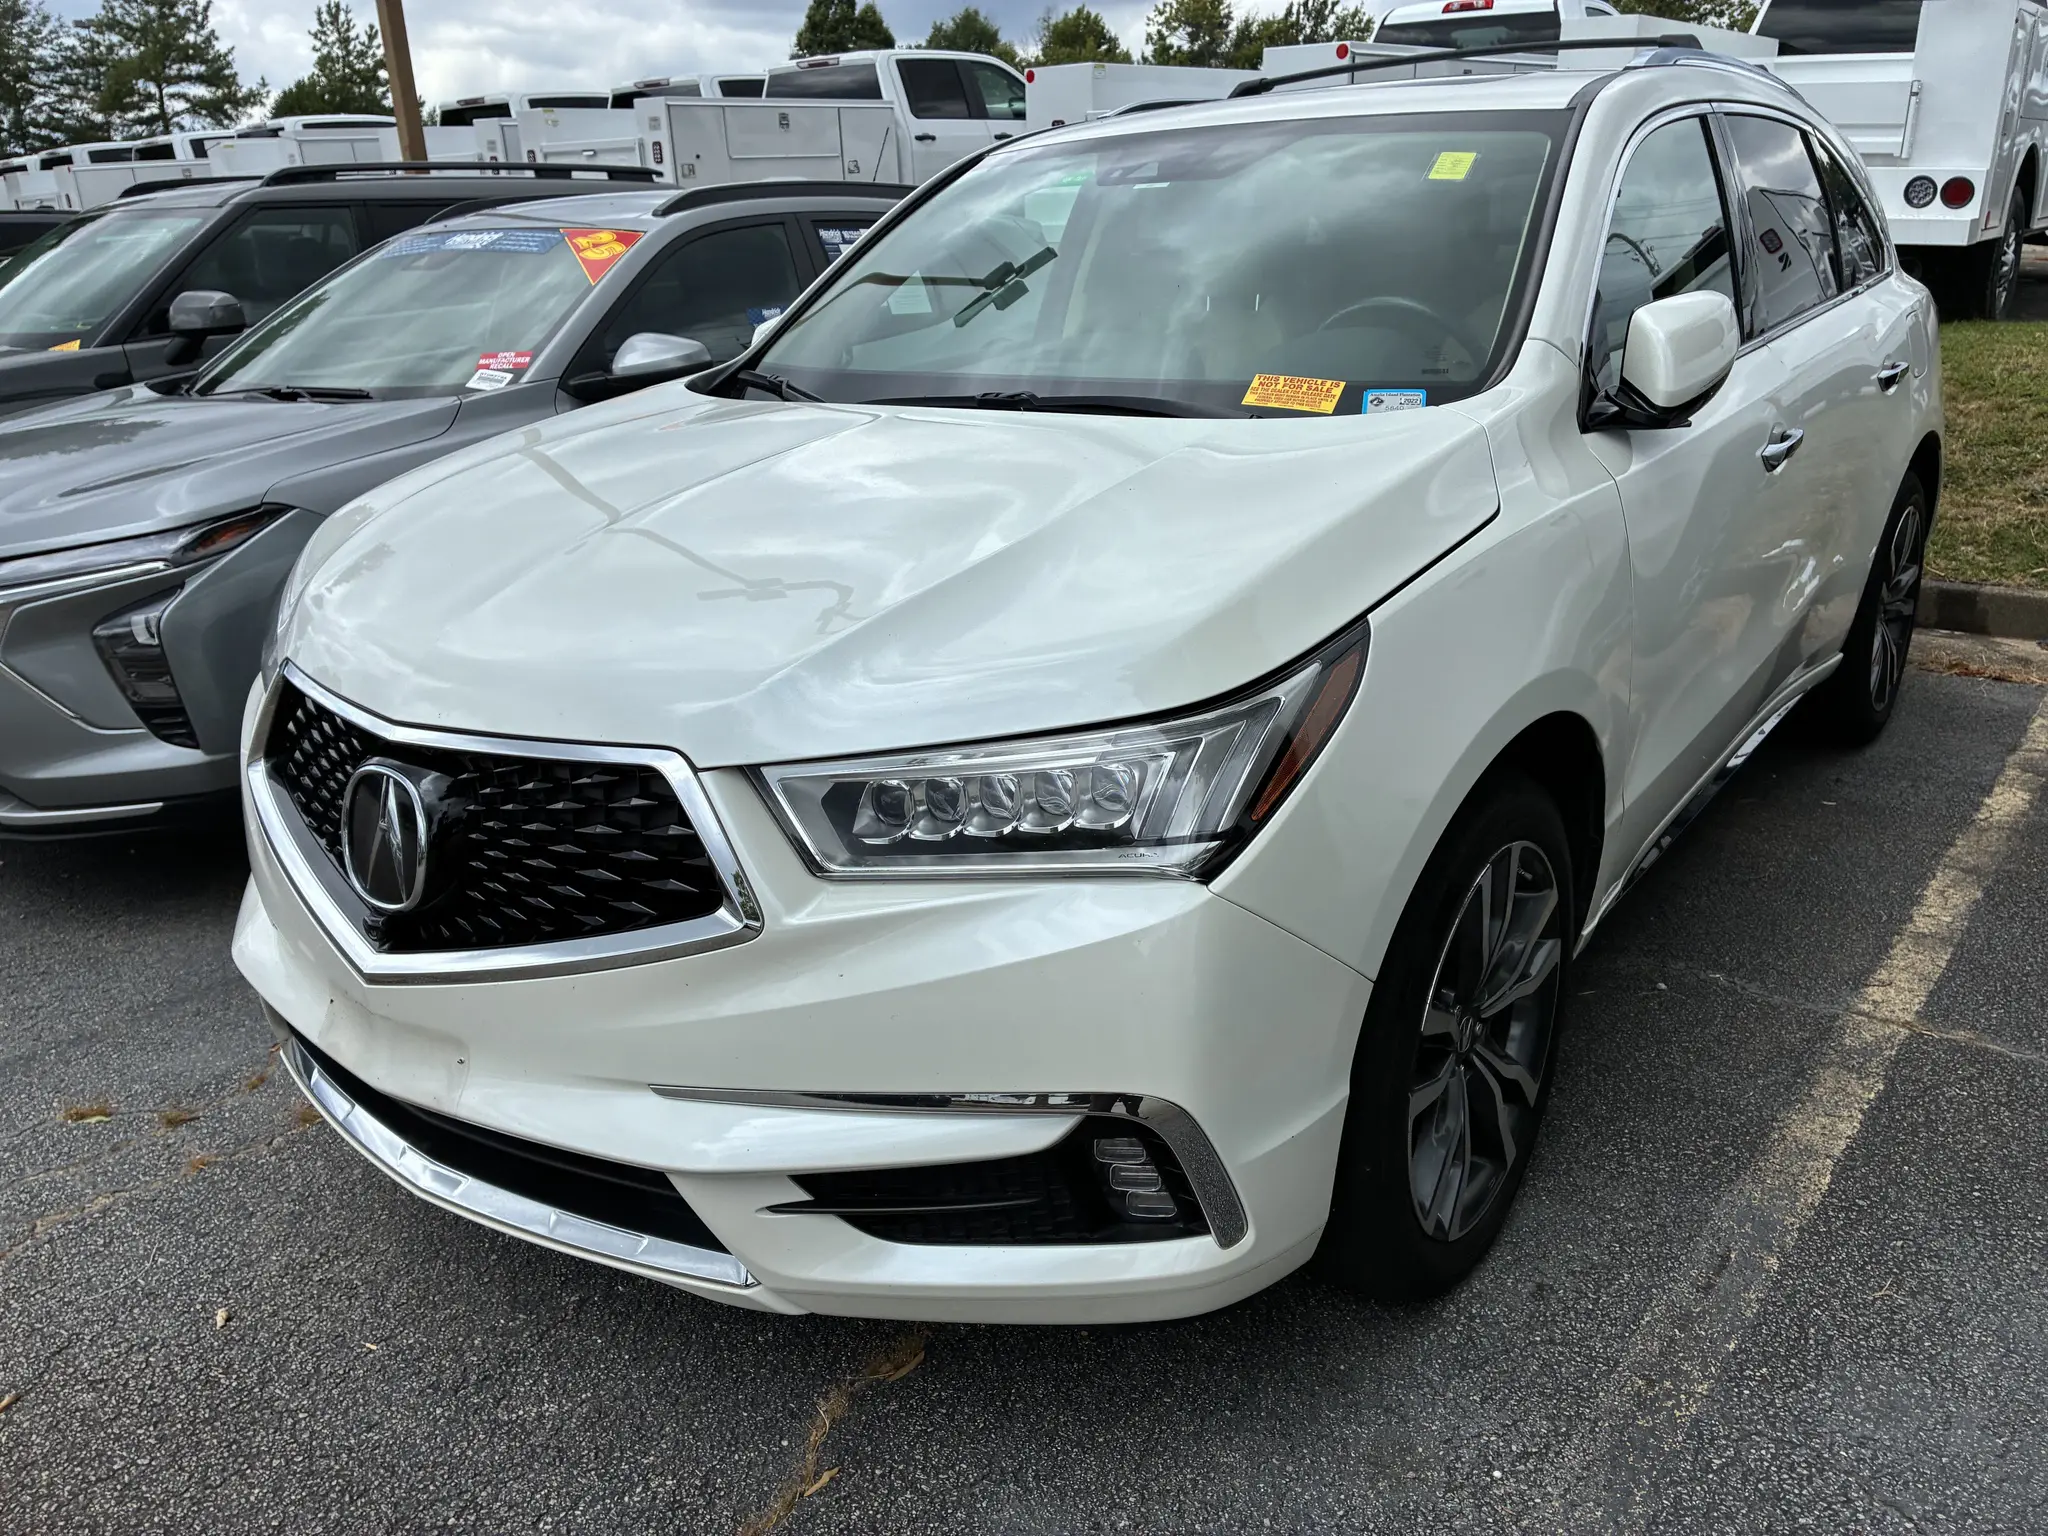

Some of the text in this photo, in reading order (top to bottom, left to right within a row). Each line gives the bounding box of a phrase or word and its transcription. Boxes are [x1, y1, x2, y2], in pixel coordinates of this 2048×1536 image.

[478, 356, 531, 365] MANUFACTURER
[1283, 376, 1328, 387] VEHICLE
[1282, 383, 1304, 391] FOR
[1305, 385, 1334, 394] SALE
